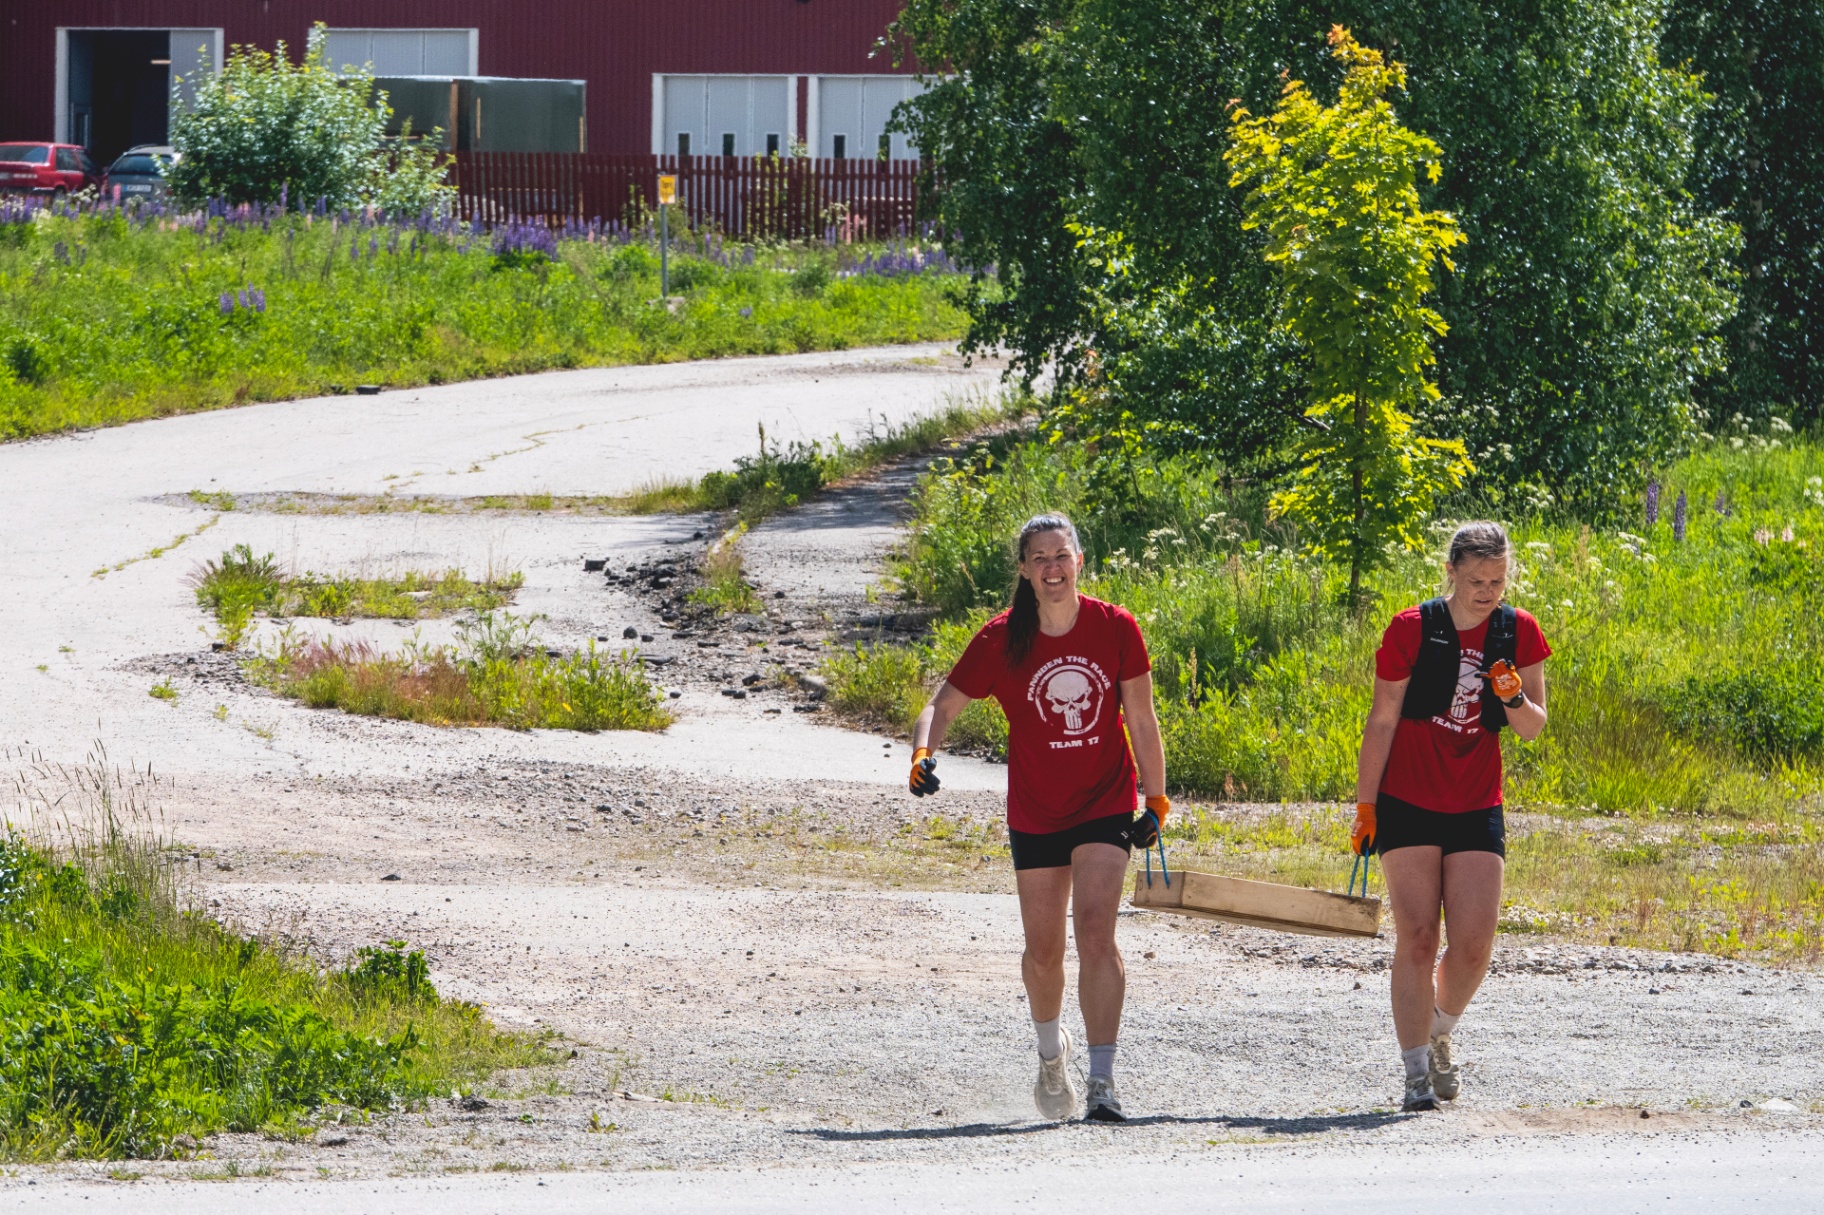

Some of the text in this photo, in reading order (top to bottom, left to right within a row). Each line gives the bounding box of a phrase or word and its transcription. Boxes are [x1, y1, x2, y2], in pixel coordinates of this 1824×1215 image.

[1066, 655, 1088, 665] THE
[1090, 662, 1111, 690] RACE
[1432, 715, 1463, 733] TEAM
[1049, 736, 1099, 749] TEAM 17
